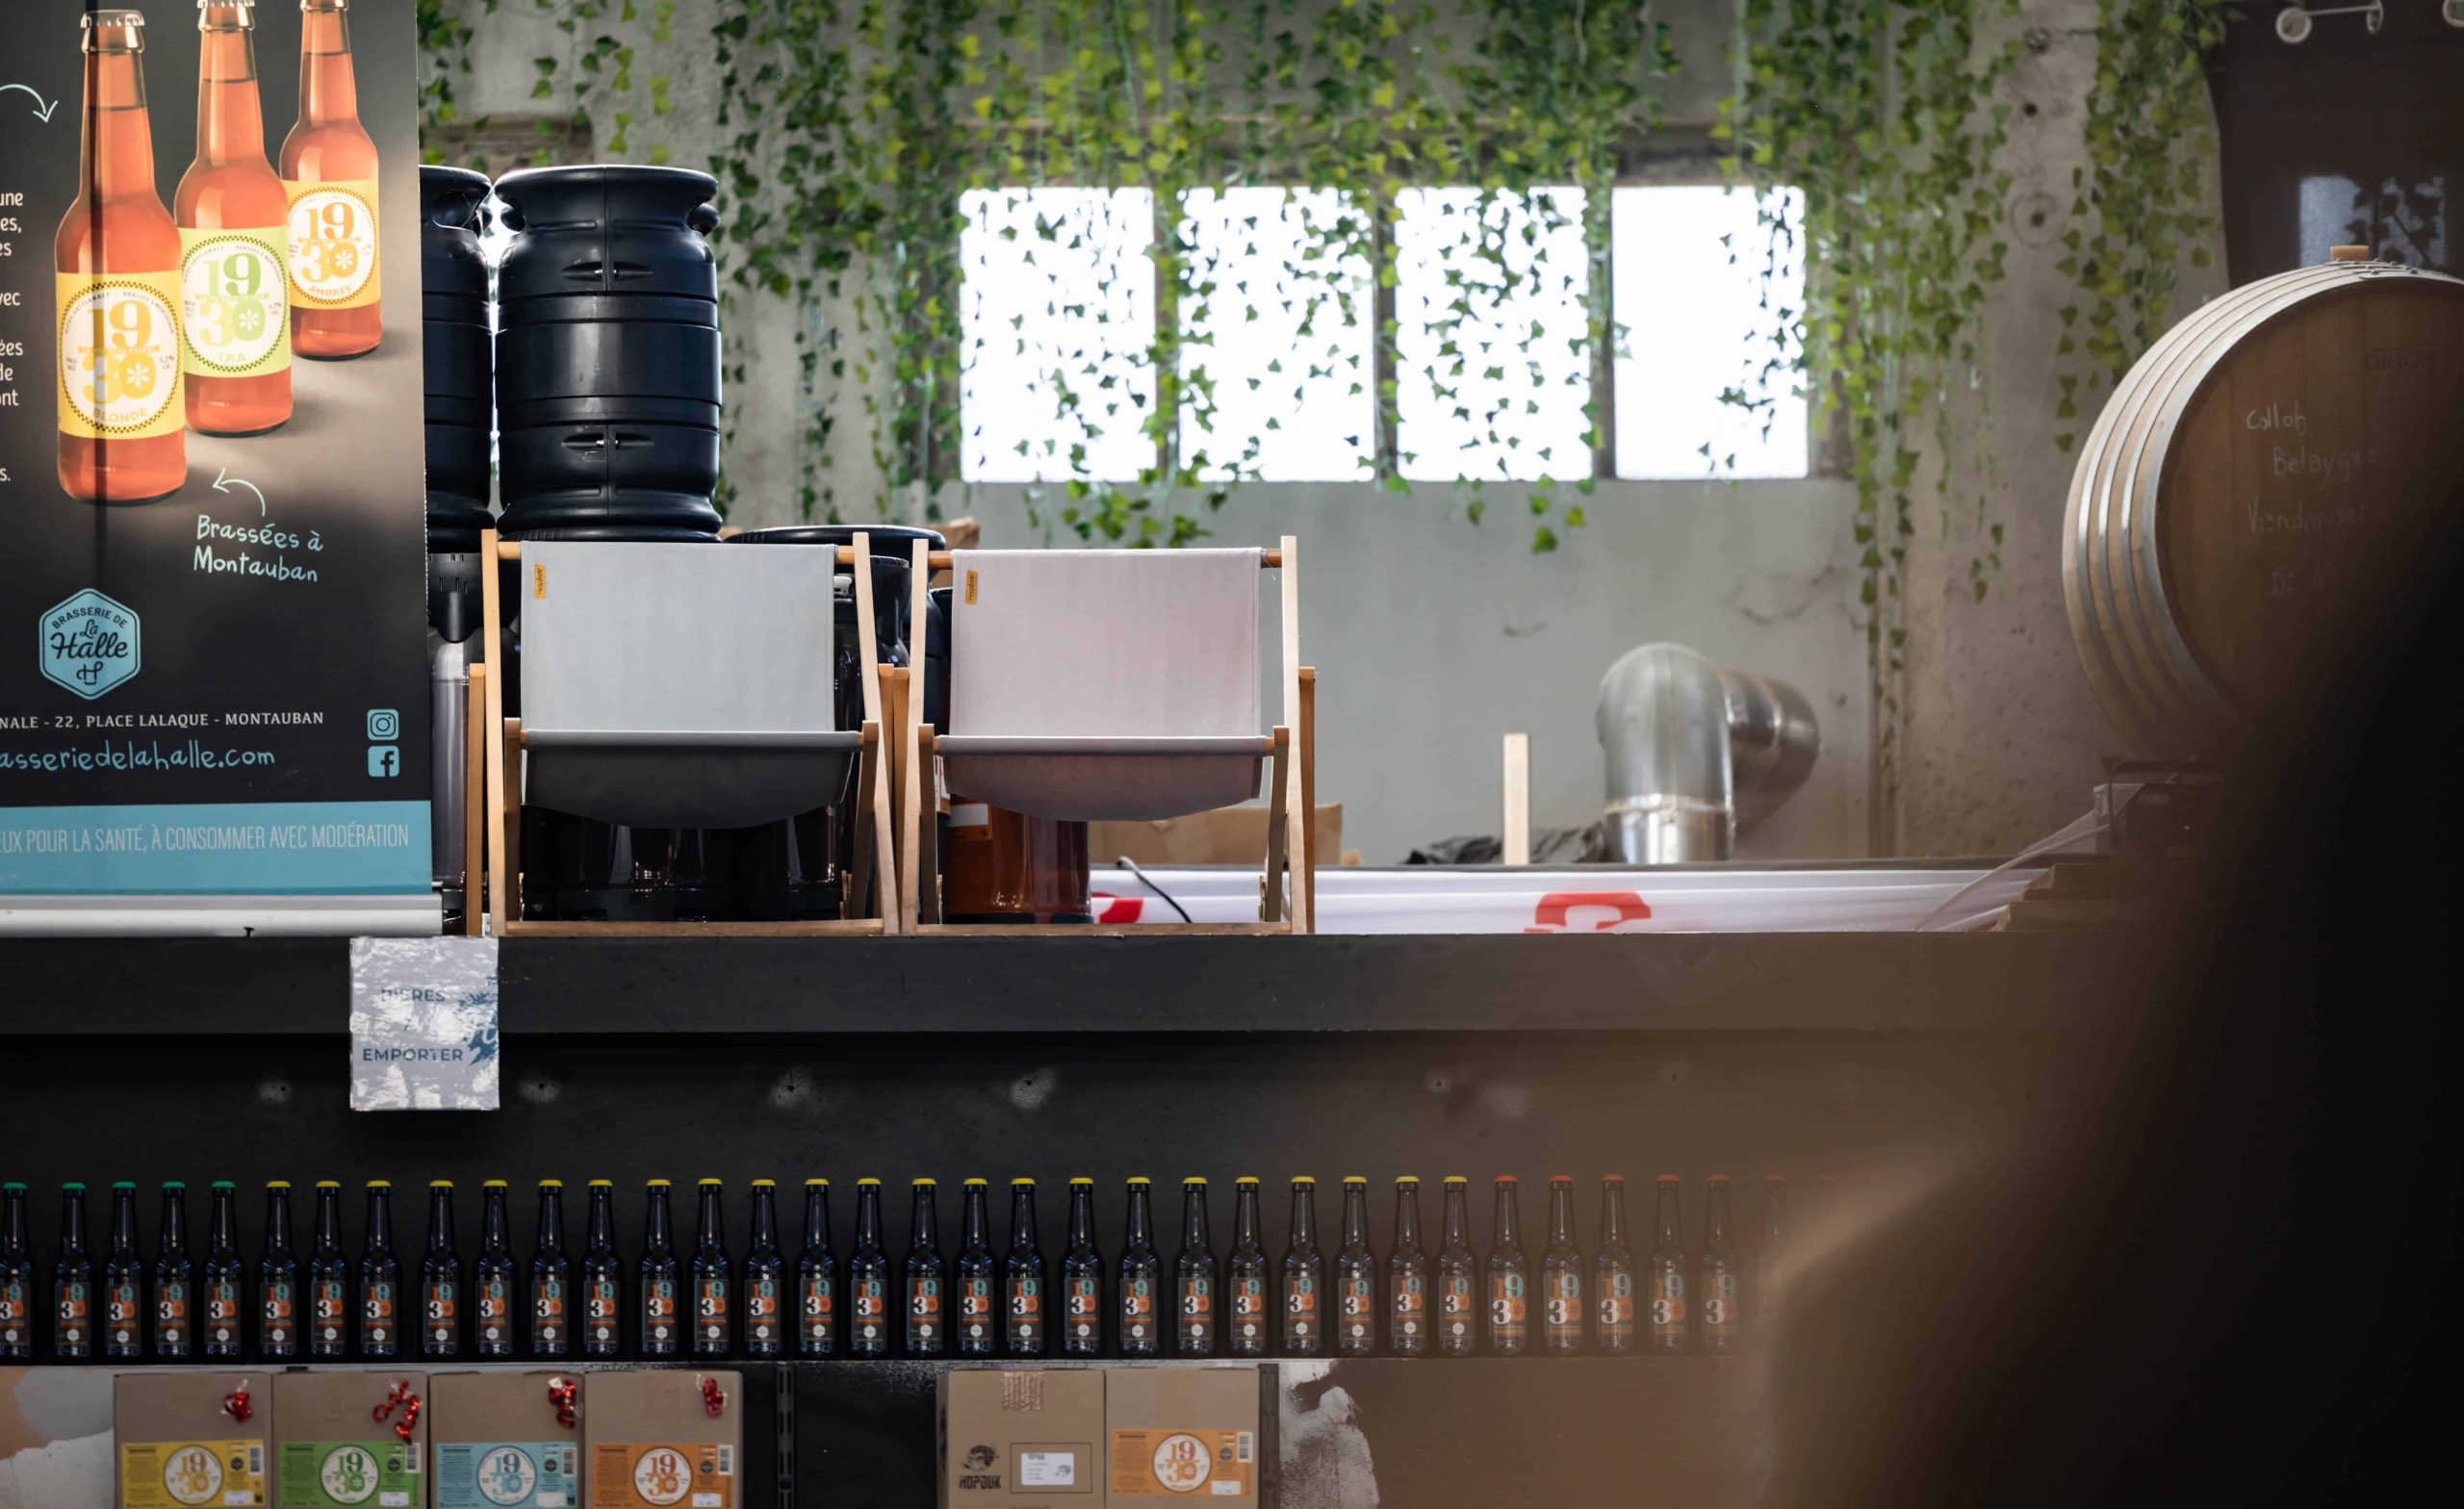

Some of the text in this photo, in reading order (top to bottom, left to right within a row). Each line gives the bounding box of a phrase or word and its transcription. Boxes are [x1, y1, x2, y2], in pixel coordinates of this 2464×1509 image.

[306, 202, 354, 240] 19
[204, 253, 261, 295] 19
[88, 300, 151, 351] 19
[0, 390, 19, 406] nt
[93, 407, 147, 422] BLONDE
[196, 514, 323, 551] Brassées à
[193, 545, 318, 582] Montauban
[51, 607, 128, 629] BRASSERIE DE
[79, 619, 99, 639] La
[50, 631, 129, 659] Halle
[0, 716, 38, 729] NALE
[55, 715, 81, 729] 22,
[87, 714, 134, 729] PLACE
[139, 713, 209, 729] LALAQUE
[224, 712, 323, 726] MONTAUBAN
[0, 739, 275, 771] asseriedelahalle.com
[26, 829, 68, 854] POUR
[72, 828, 91, 852] LA
[95, 824, 147, 854] SANTÉ,
[151, 824, 162, 851] À
[166, 825, 266, 851] CONSOMMER
[270, 825, 308, 849] AVEC
[311, 819, 409, 849] MODÉRATION
[381, 989, 446, 1002] RES
[363, 1048, 464, 1062] EMPORTER
[3, 1283, 24, 1300] 19
[64, 1284, 85, 1301] 19
[113, 1285, 134, 1302] 19
[163, 1283, 184, 1300] 19
[214, 1283, 235, 1300] 19
[270, 1283, 291, 1300] 19
[321, 1282, 342, 1299] 19
[370, 1283, 391, 1300] 19
[432, 1283, 453, 1300] 19
[483, 1282, 504, 1299] 19
[540, 1282, 561, 1299] 19
[593, 1282, 614, 1299] 19
[652, 1281, 673, 1298] 19
[704, 1281, 725, 1298] 19
[753, 1281, 774, 1298] 19
[809, 1279, 831, 1296] 19
[860, 1280, 882, 1297] 19
[916, 1279, 937, 1296] 19
[966, 1279, 988, 1296] 19
[1015, 1279, 1037, 1296] 19
[1073, 1279, 1094, 1296] 19
[1128, 1280, 1149, 1297] 19
[1187, 1279, 1208, 1296] 19
[1240, 1279, 1261, 1296] 19
[1292, 1277, 1313, 1294] 19
[1348, 1279, 1369, 1296] 19
[1399, 1277, 1421, 1294] 19
[1448, 1277, 1469, 1294] 19
[1496, 1273, 1524, 1298] 19
[1552, 1273, 1580, 1298] 19
[1604, 1273, 1631, 1298] 19
[1656, 1274, 1683, 1299] 19
[1169, 1440, 1196, 1461] 19
[181, 1452, 206, 1473] 19
[338, 1452, 363, 1472] 19
[495, 1453, 521, 1473] 19
[651, 1454, 677, 1474] 19
